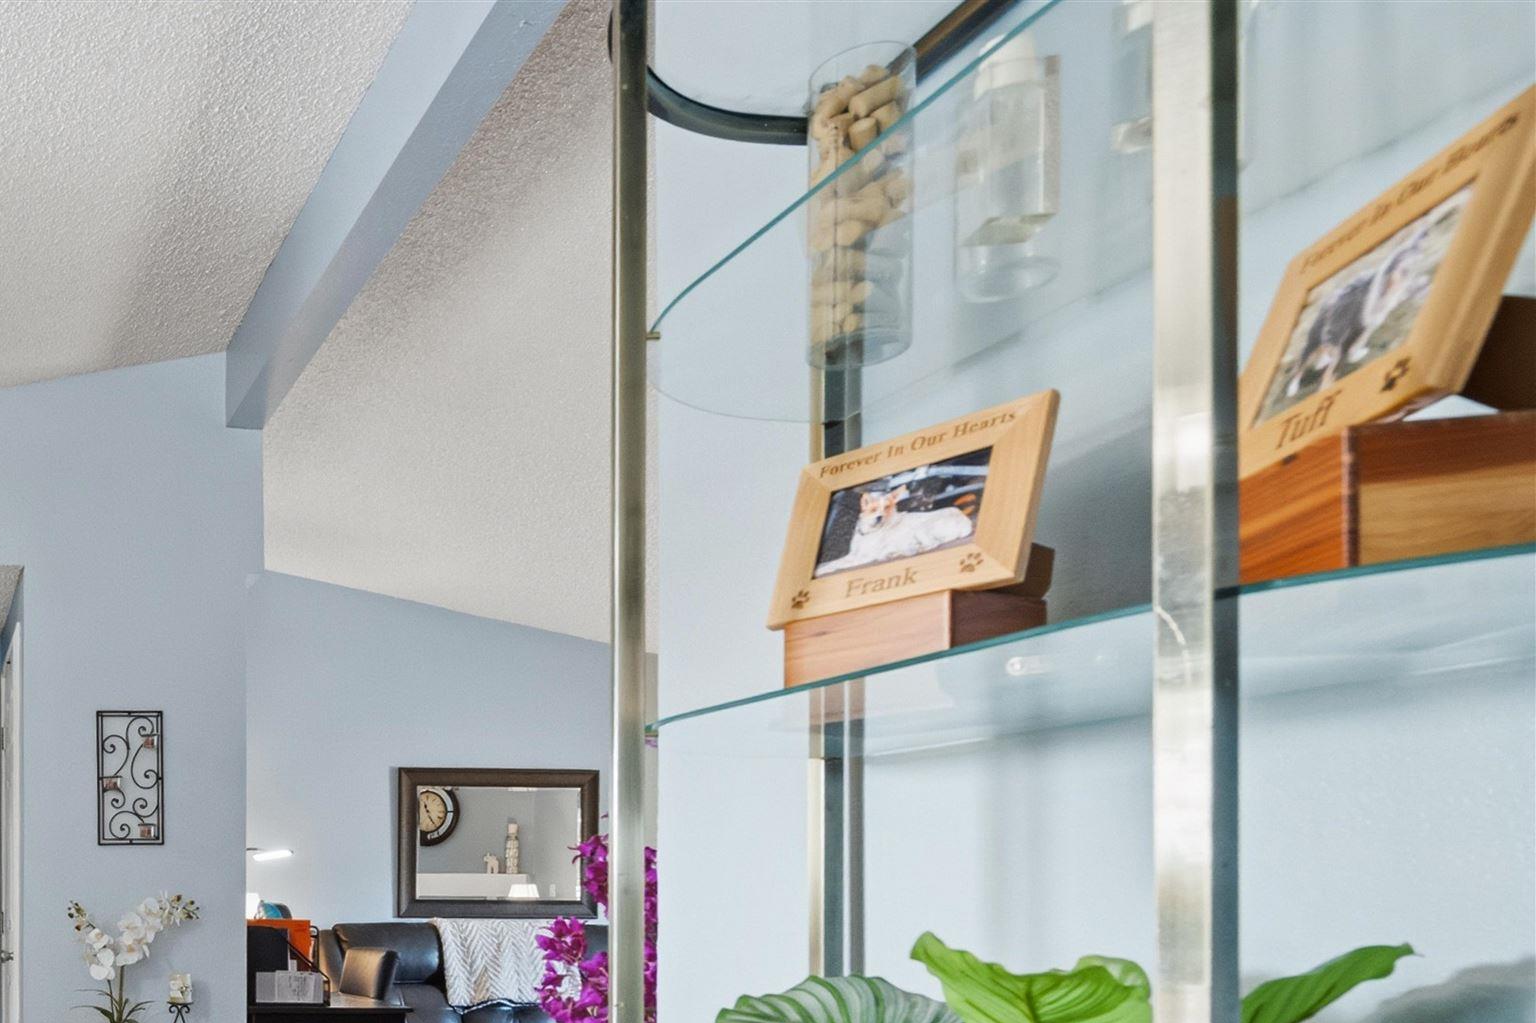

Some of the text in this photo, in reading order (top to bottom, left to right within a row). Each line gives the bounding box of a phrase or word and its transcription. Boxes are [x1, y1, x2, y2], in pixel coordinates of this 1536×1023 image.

[820, 412, 1016, 478] Forever In Our Hearts
[1276, 390, 1342, 449] Tuff
[846, 568, 917, 597] Frank
